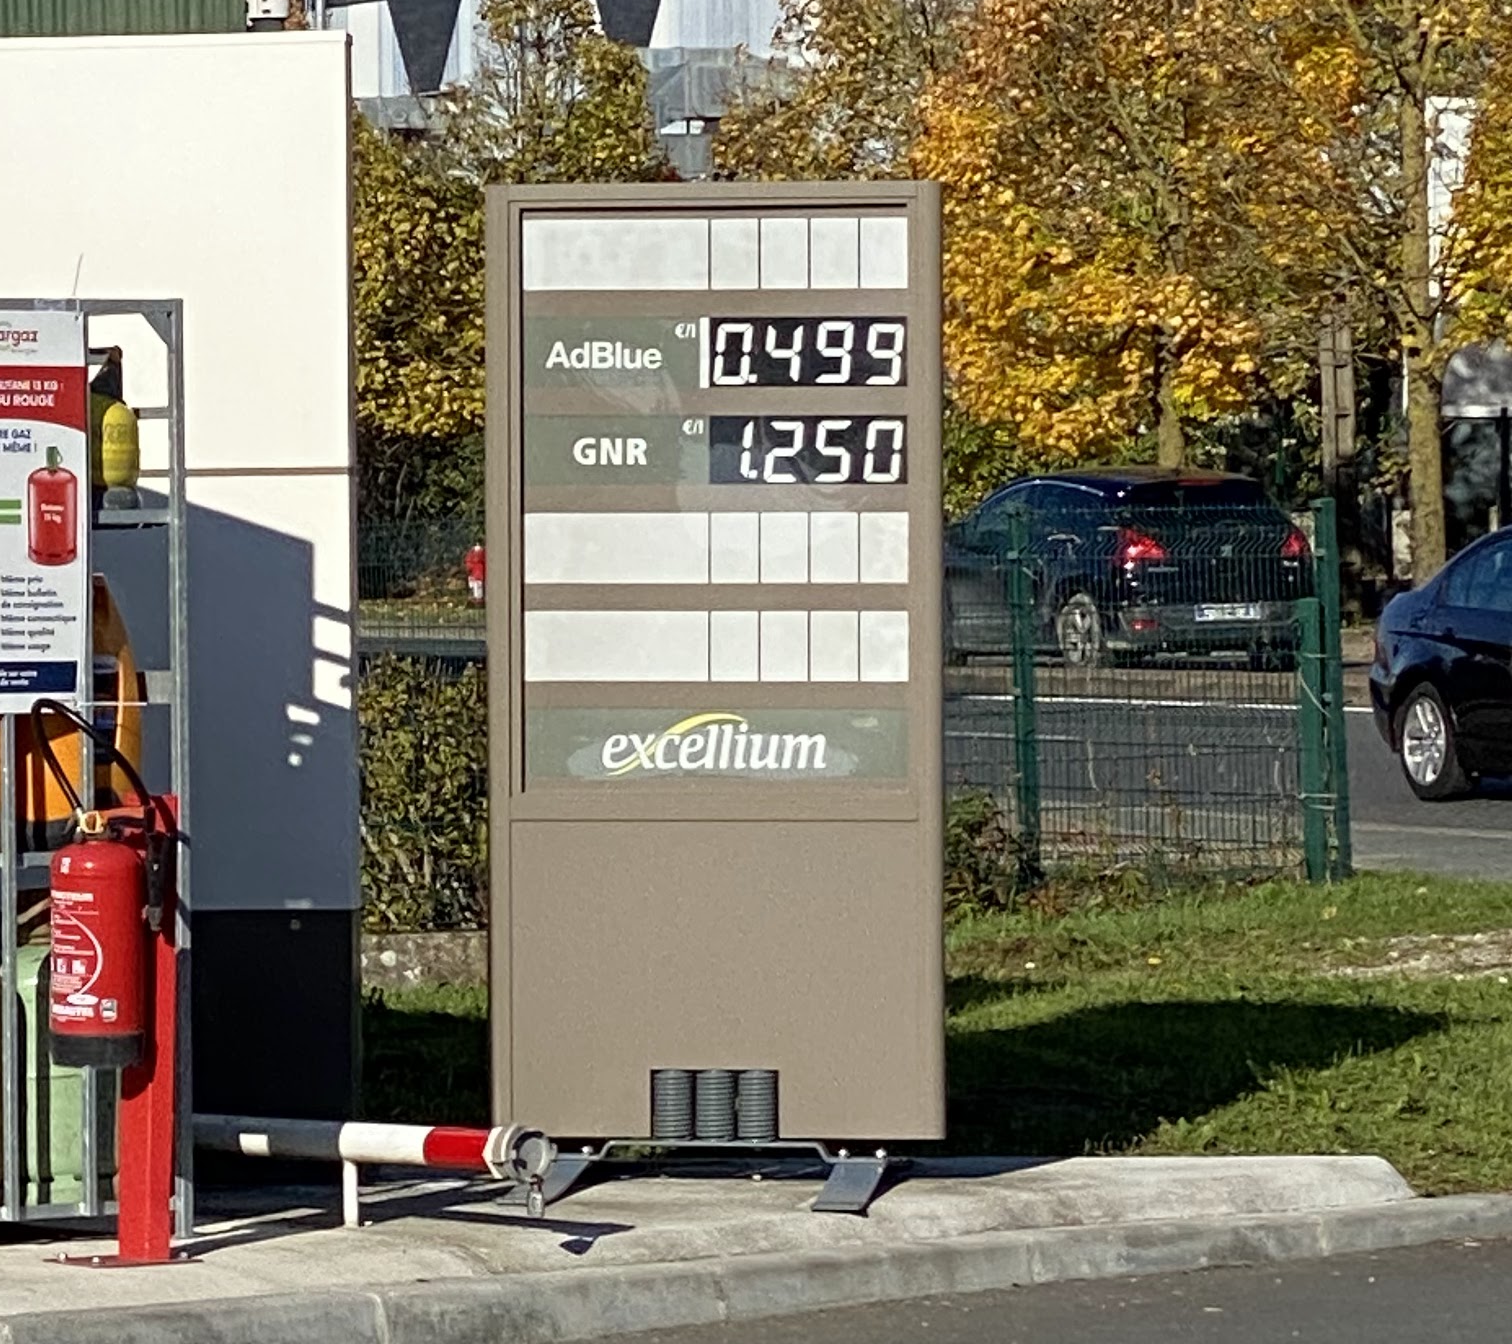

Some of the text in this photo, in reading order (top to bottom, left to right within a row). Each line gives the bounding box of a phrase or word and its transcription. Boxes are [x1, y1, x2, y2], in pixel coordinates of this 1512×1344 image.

[545, 341, 662, 371] AdBlue
[713, 321, 905, 386] 0.499
[13, 394, 55, 407] ROUGE
[2, 440, 31, 453] MÊME
[11, 428, 32, 439] GAZ
[572, 437, 648, 466] GNR
[740, 419, 903, 483] 1.250
[601, 719, 827, 771] excellium
